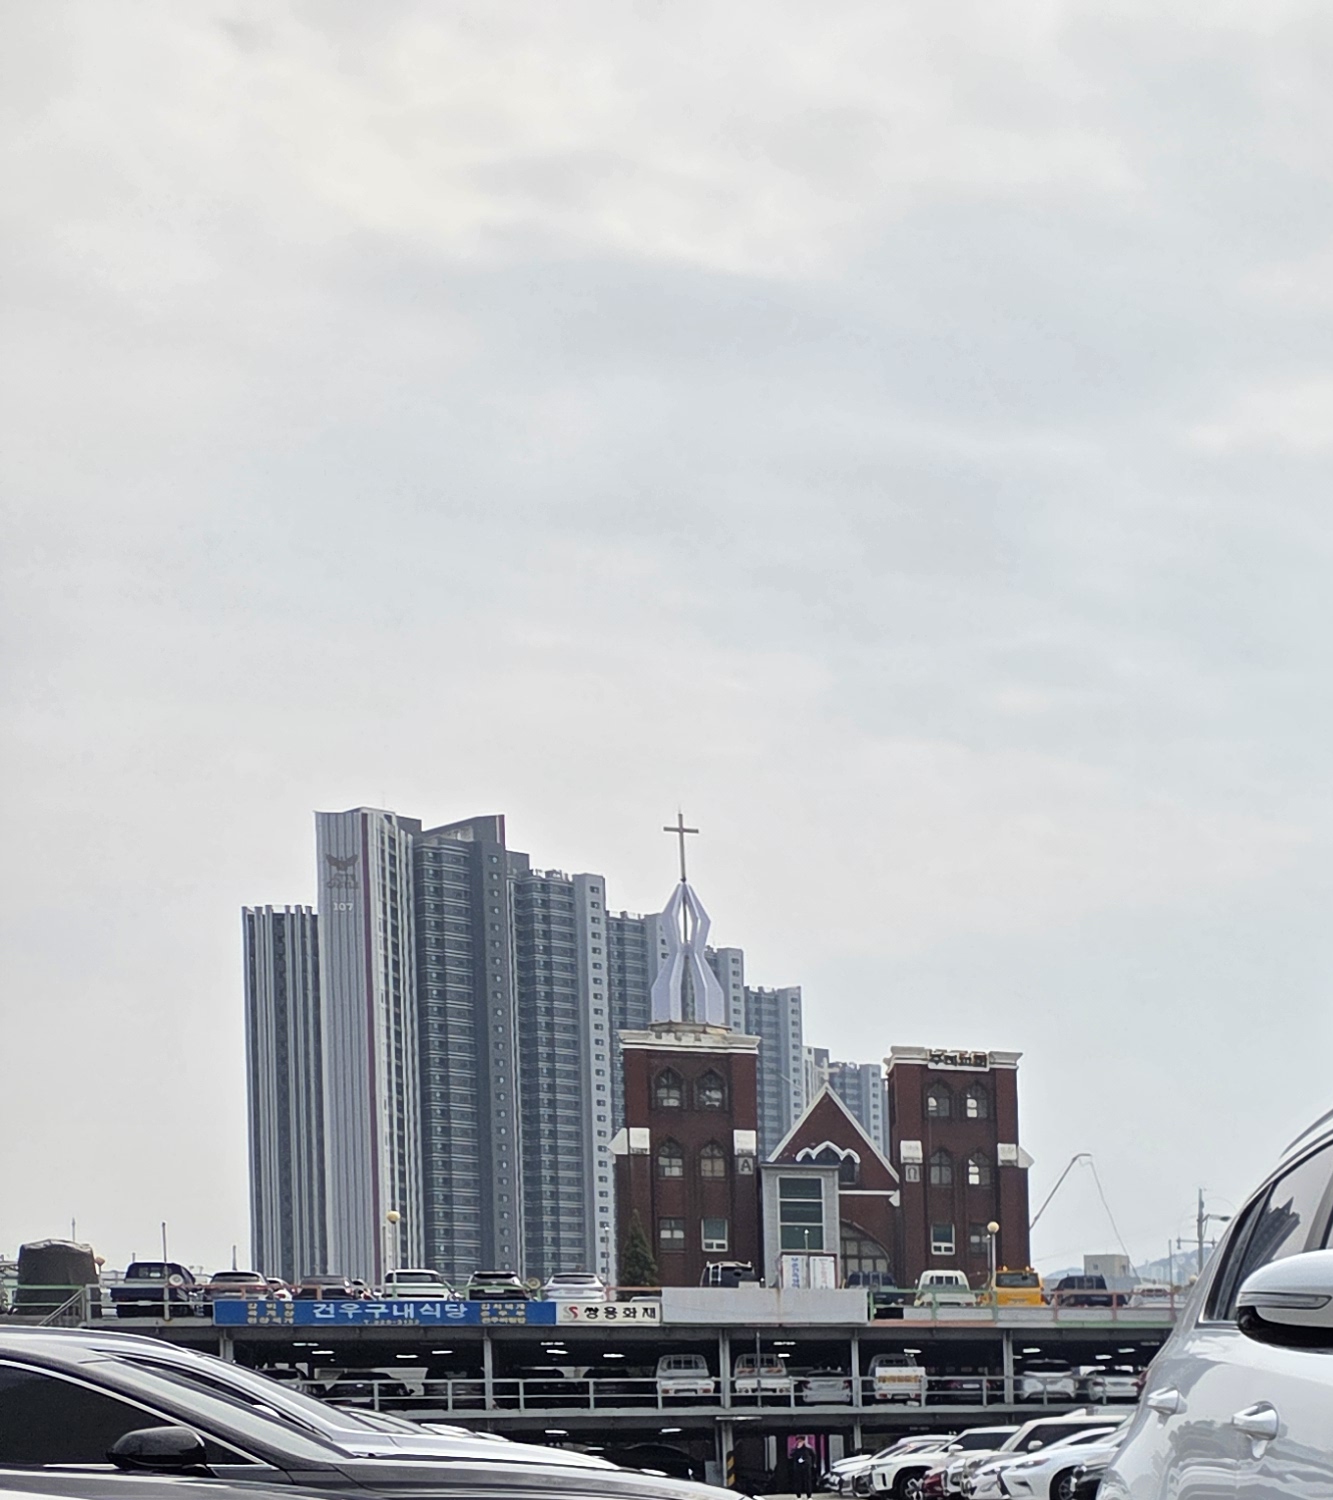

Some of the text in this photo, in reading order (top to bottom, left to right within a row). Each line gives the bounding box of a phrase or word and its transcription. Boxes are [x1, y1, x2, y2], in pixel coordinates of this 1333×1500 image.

[333, 902, 353, 911] 107
[313, 1303, 468, 1319] 건우구내식당
[584, 1306, 656, 1320] 쌍용화재
